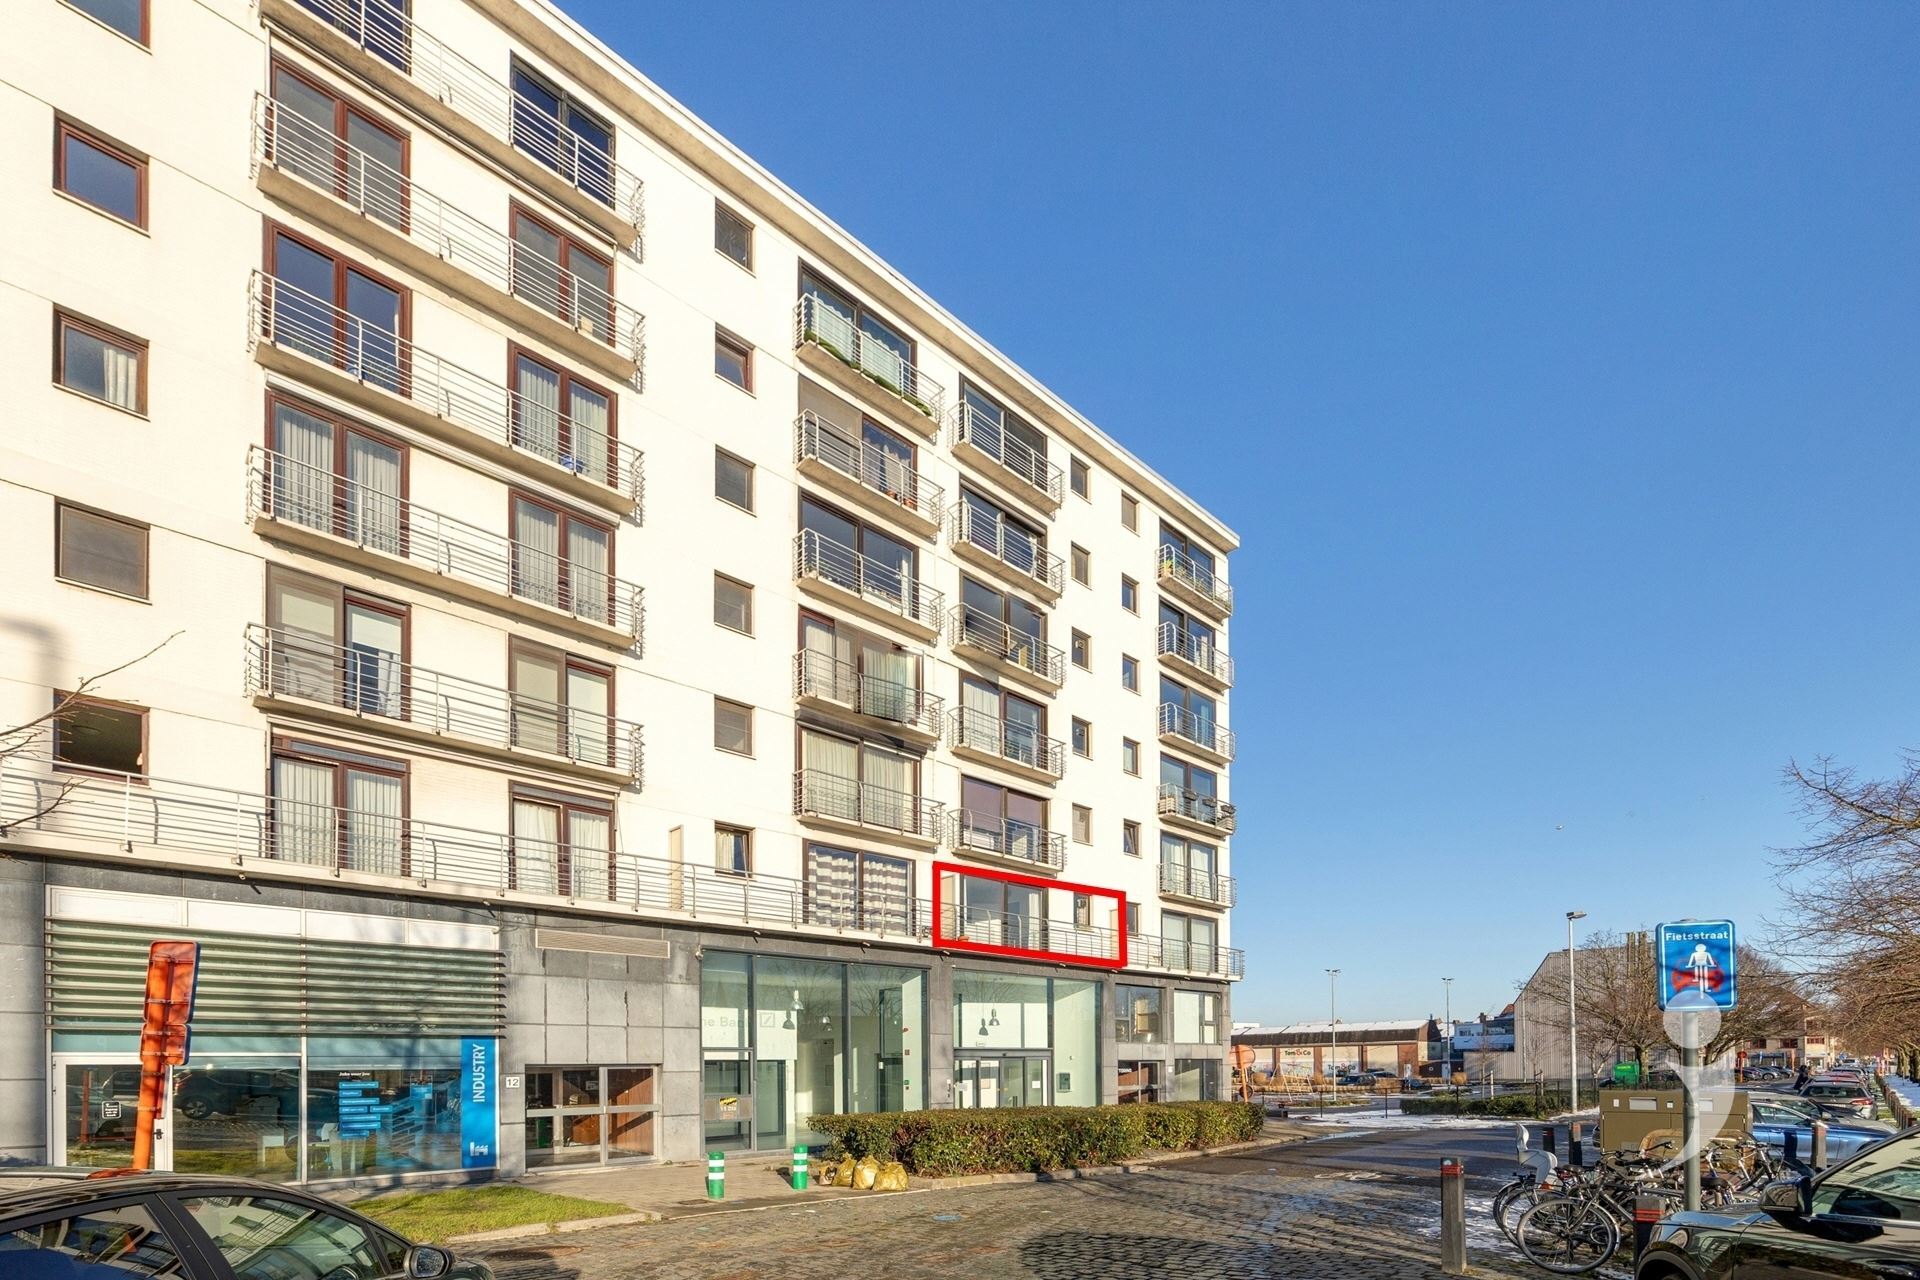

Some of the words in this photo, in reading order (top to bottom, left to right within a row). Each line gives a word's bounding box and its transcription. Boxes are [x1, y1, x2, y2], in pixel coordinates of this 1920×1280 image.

[1665, 931, 1729, 941] Fietsstraat
[472, 1043, 486, 1102] INDUSTRY
[507, 1078, 519, 1087] 12
